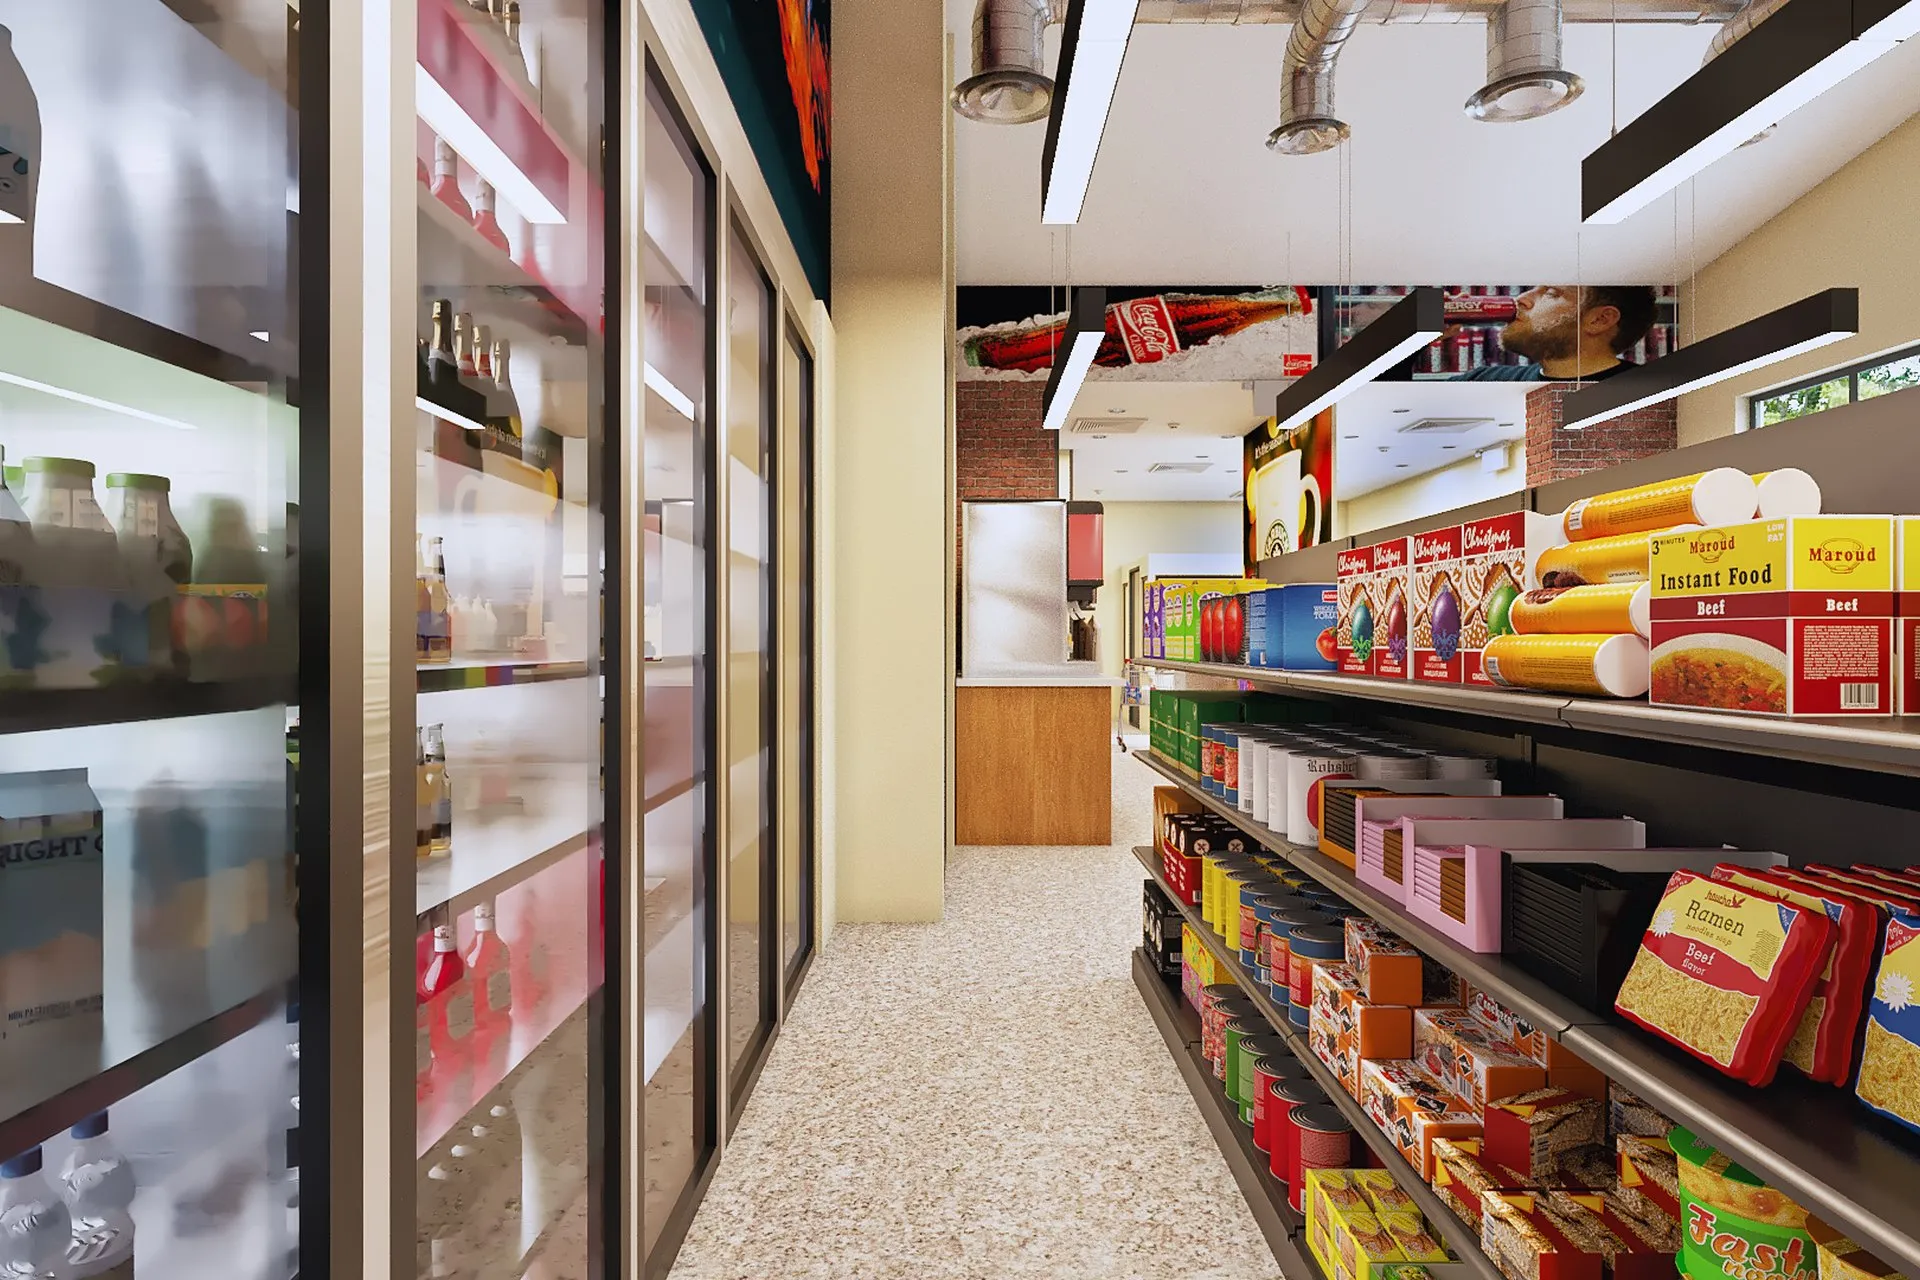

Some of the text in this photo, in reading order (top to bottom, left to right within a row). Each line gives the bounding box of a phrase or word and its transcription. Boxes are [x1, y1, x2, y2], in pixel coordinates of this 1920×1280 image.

[1133, 304, 1171, 354] Coca-Cola
[1129, 334, 1147, 359] CLASSIC
[1767, 523, 1785, 532] LOW
[1768, 533, 1785, 542] FAT
[1465, 526, 1510, 550] Christmas
[1652, 540, 1660, 555] 3
[1690, 535, 1736, 554] Maroud
[1414, 538, 1451, 559] Christmas
[1809, 547, 1876, 561] Maroud
[1660, 569, 1721, 591] Instant
[1728, 563, 1773, 586] Food
[1697, 599, 1726, 616] Beef
[1825, 598, 1859, 612] Beef
[1685, 900, 1745, 937] Ramen
[1685, 942, 1716, 966] Beef
[1681, 958, 1706, 977] flavor
[1688, 1202, 1804, 1276] Fast
